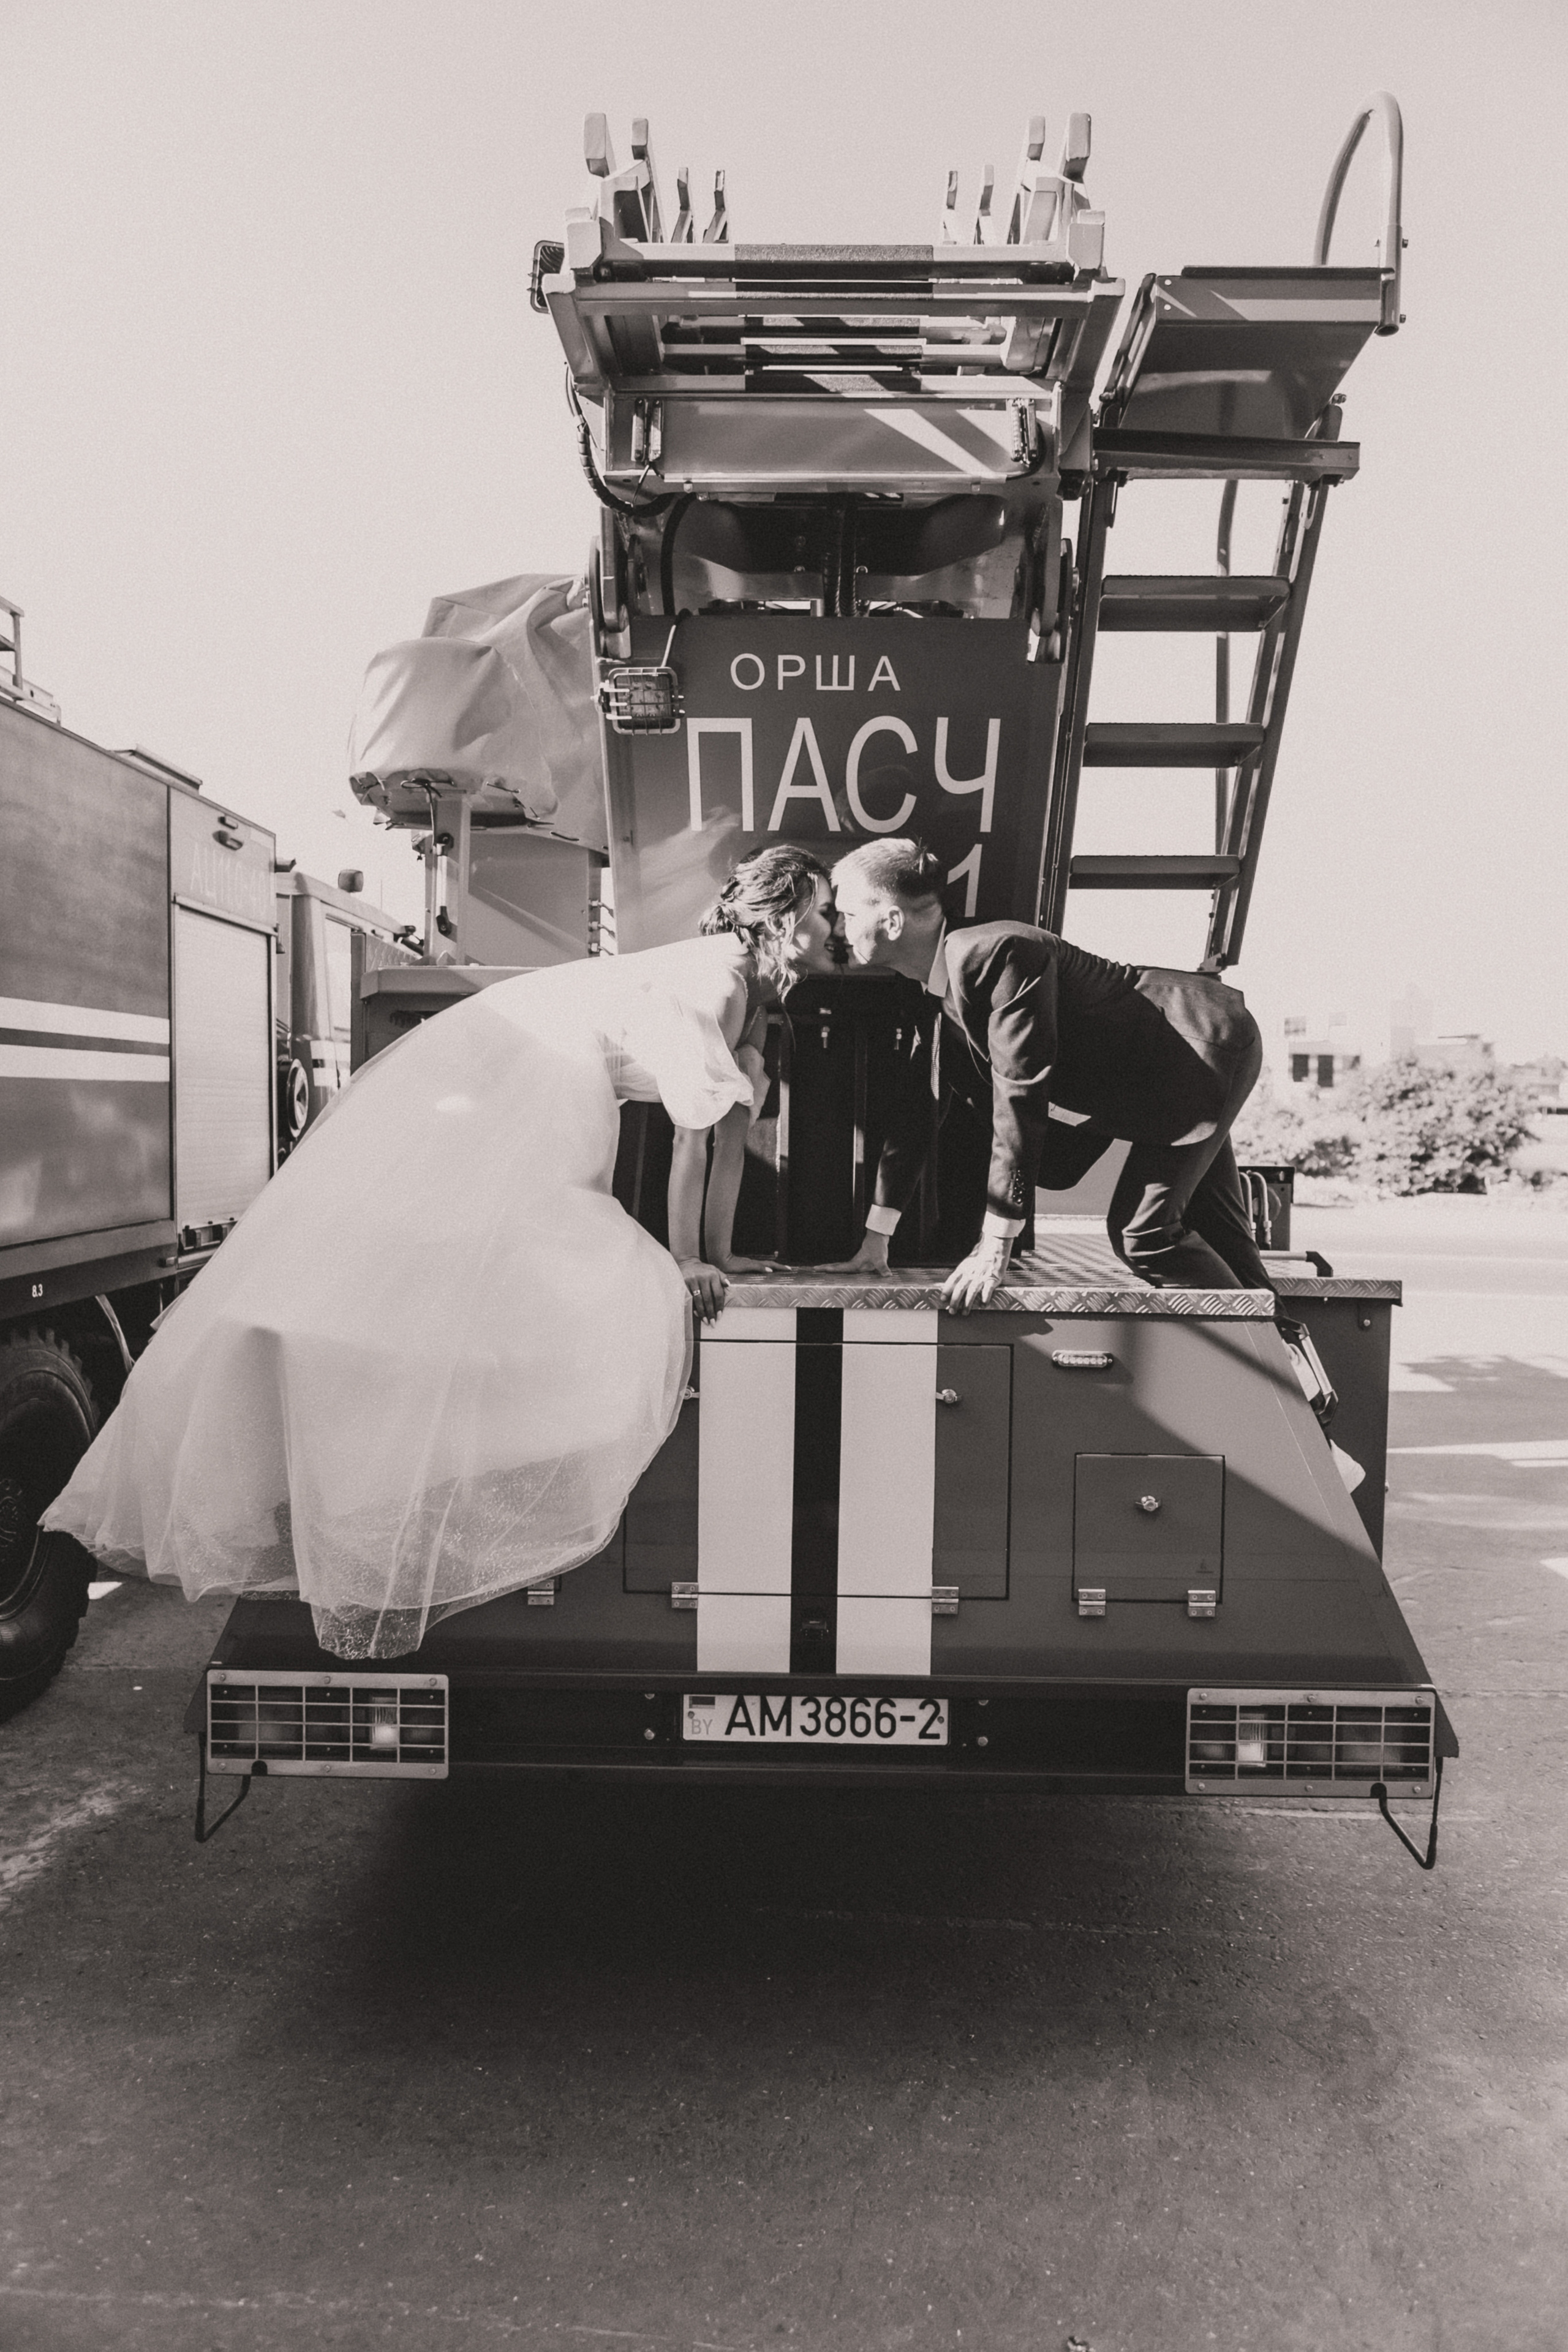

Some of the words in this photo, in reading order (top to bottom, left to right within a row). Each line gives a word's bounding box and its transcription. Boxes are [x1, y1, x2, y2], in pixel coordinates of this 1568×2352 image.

[730, 653, 901, 692] ОРША
[686, 715, 1001, 833] ПАСЧ
[692, 1719, 713, 1735] BY
